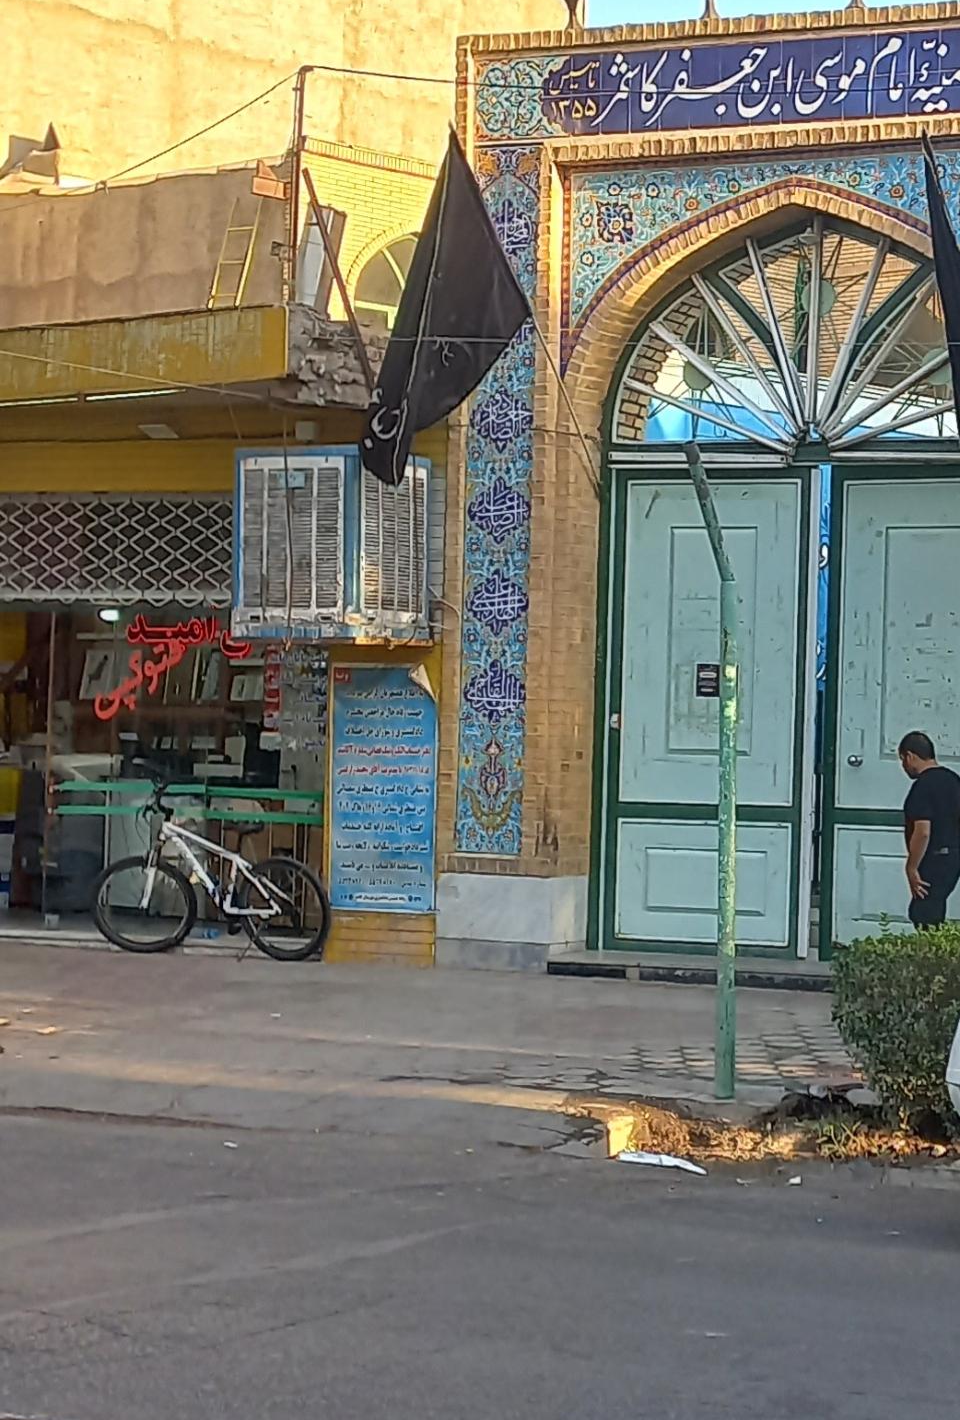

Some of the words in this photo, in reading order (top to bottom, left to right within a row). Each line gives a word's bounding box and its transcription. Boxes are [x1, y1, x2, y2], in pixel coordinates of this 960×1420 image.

[590, 52, 668, 128] کاشمر
[644, 46, 769, 127] جعفر
[736, 56, 794, 120] ابن
[795, 51, 867, 116] موسی
[865, 37, 917, 115] امام
[549, 98, 598, 121] ۱۳۵۵
[127, 612, 219, 645] امید
